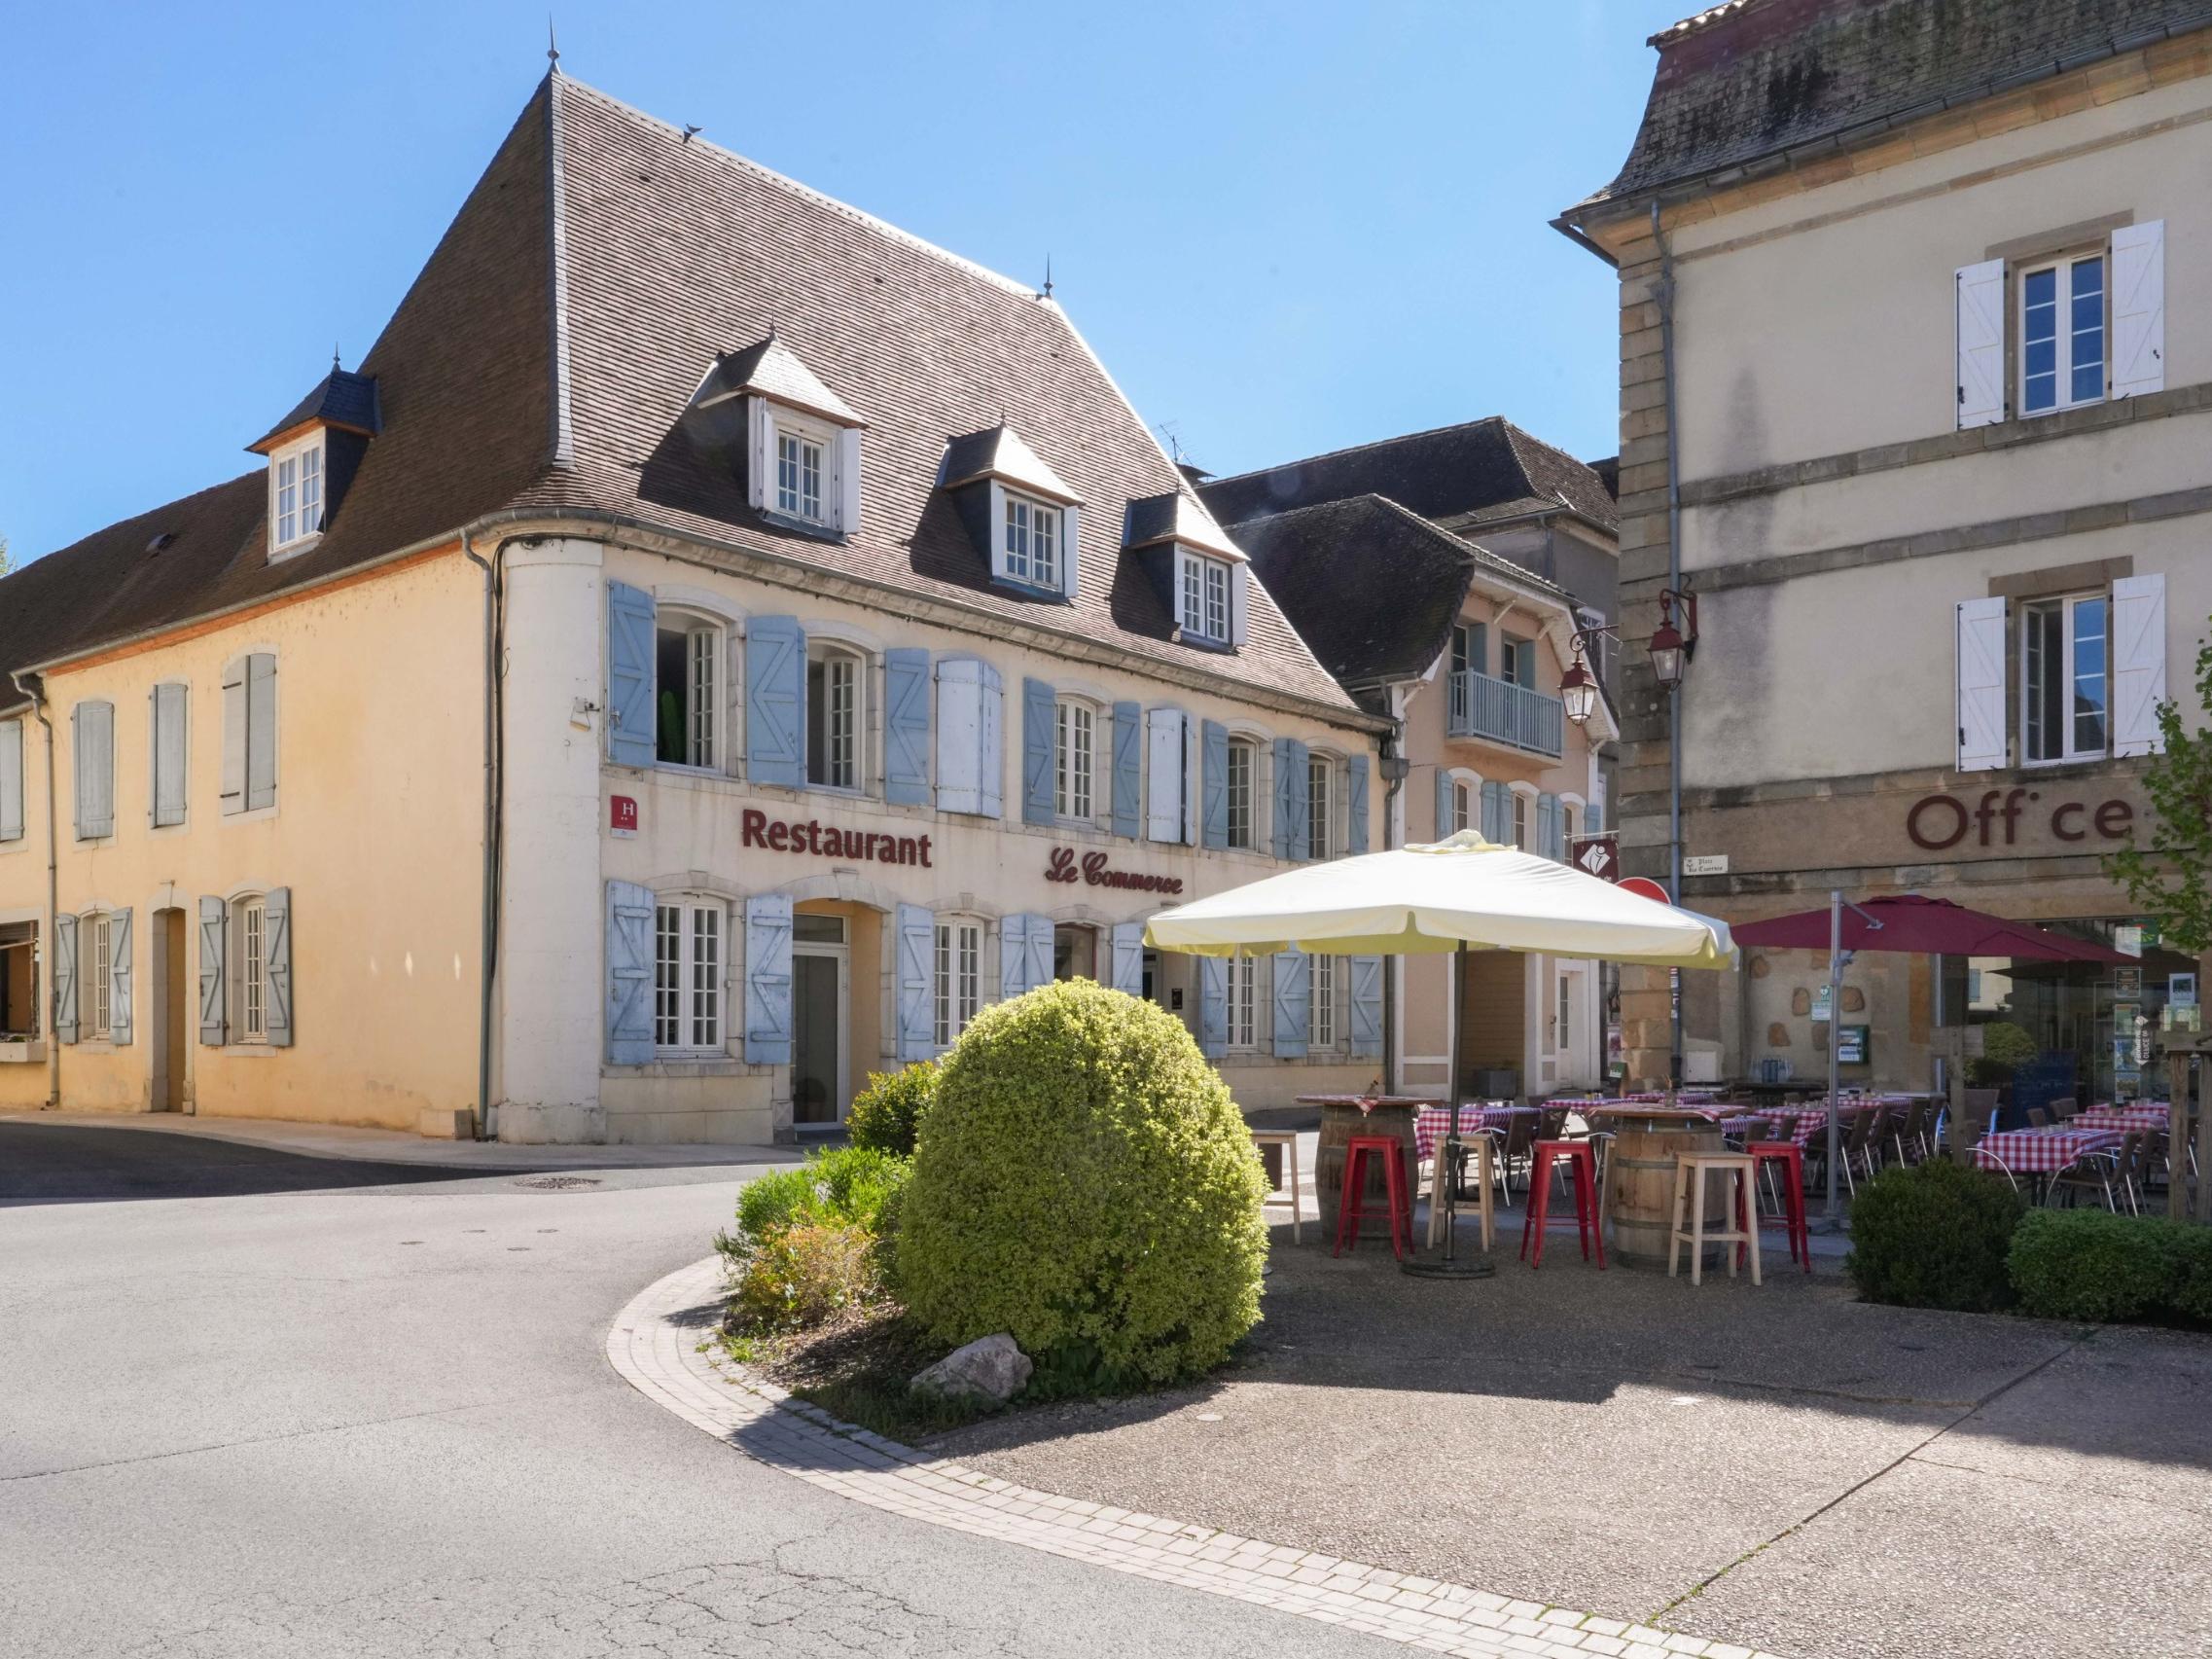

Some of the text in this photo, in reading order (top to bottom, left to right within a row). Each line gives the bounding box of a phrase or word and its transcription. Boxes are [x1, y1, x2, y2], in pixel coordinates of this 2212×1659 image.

[623, 803, 634, 815] H
[1907, 788, 2133, 850] Offce
[742, 809, 933, 868] Restaurant
[1045, 847, 1184, 894] Le Commerce
